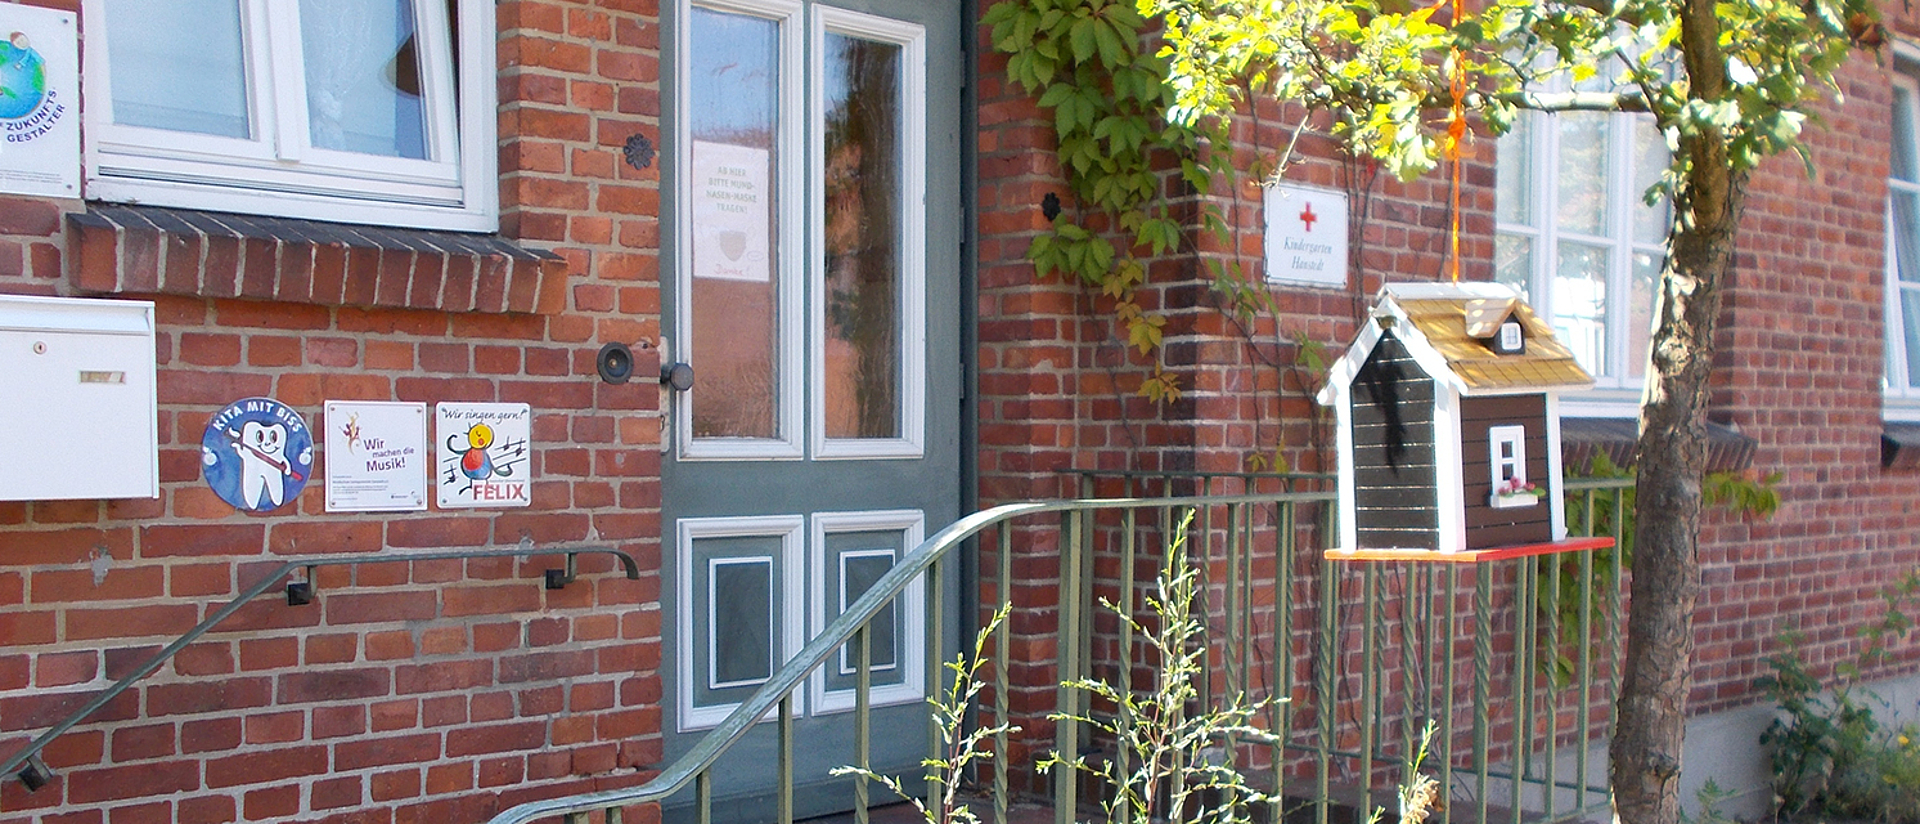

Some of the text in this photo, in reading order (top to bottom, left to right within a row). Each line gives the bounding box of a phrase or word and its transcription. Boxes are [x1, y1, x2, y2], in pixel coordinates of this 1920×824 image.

[7, 104, 65, 142] GESTALTER
[717, 166, 747, 177] AB HIER
[708, 177, 755, 190] BITTE MUND-
[706, 189, 757, 203] NASEN-MASKE
[716, 203, 748, 214] TRAGEN!
[1284, 236, 1332, 254] Kindergarten
[213, 402, 303, 432] KITA MIT BISS
[445, 410, 464, 419] Wir
[465, 409, 495, 423] singen
[363, 438, 385, 450] Wir
[373, 446, 415, 458] machen die
[366, 457, 406, 472] Musik!
[473, 483, 525, 500] FELIX
